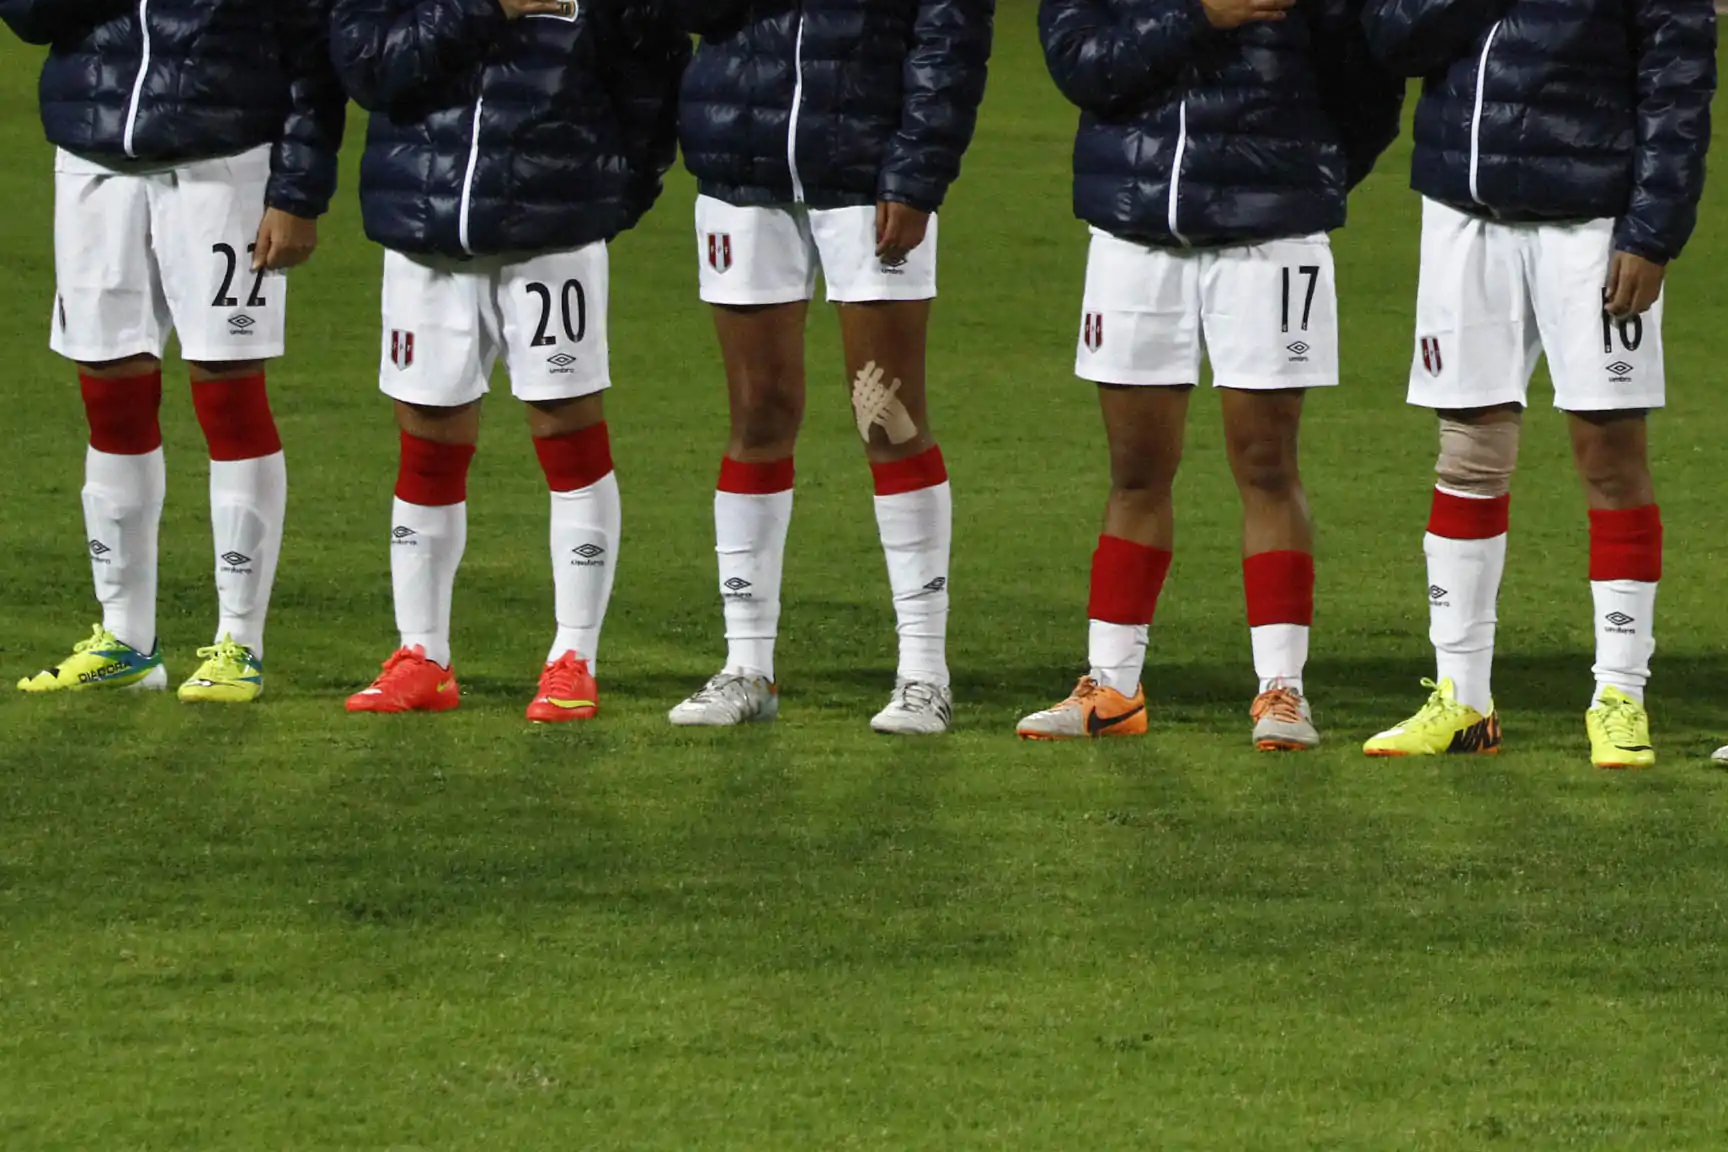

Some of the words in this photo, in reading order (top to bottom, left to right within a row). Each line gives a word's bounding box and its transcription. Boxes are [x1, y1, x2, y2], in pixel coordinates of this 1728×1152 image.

[525, 278, 586, 347] 20
[1281, 265, 1320, 333] 17
[77, 660, 133, 685] DIADORA
